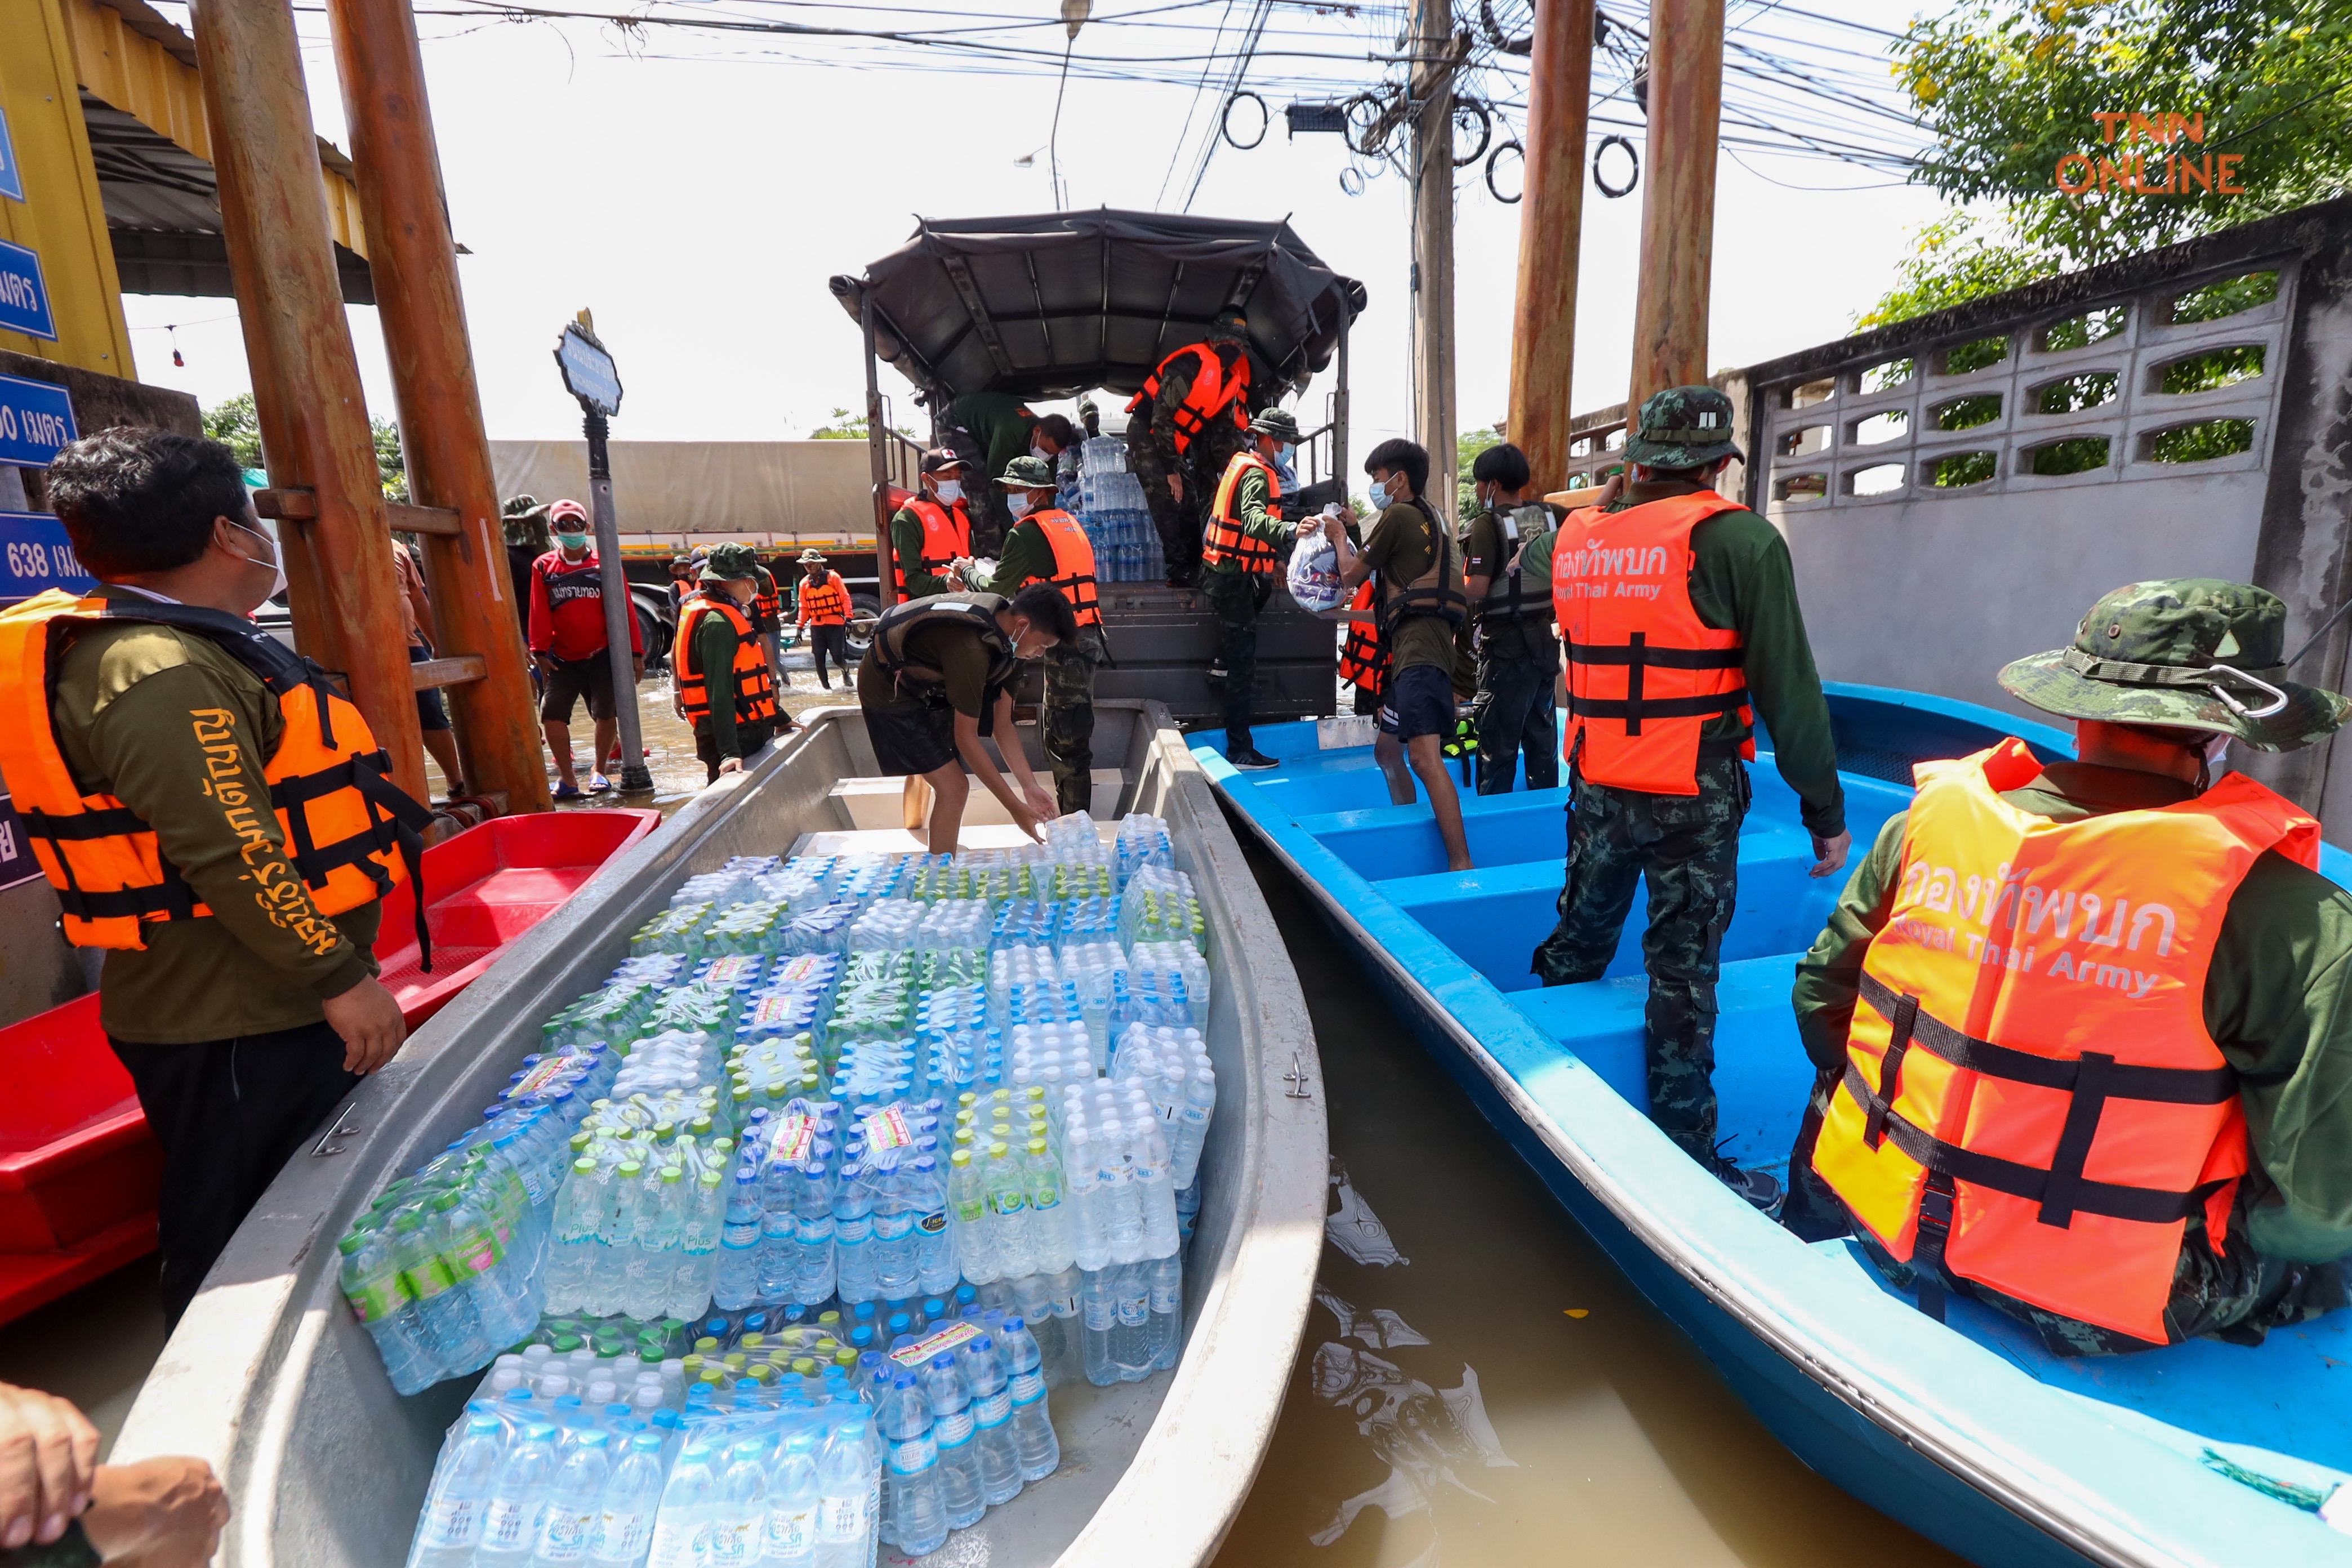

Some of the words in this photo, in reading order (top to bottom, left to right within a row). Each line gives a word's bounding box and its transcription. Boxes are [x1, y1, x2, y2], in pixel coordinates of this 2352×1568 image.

[21, 409, 68, 447] เมตร
[7, 542, 49, 577] 638
[1556, 538, 1667, 580] กองทัพบก
[1554, 584, 1573, 602] Royal
[1575, 582, 1608, 598] Thai
[1614, 581, 1662, 601] Army
[1904, 861, 2176, 957] กองทัพบก
[1894, 912, 1955, 952] Royal
[1965, 931, 2035, 973] Thai
[2047, 951, 2159, 999] Army
[688, 1235, 711, 1246] Plus
